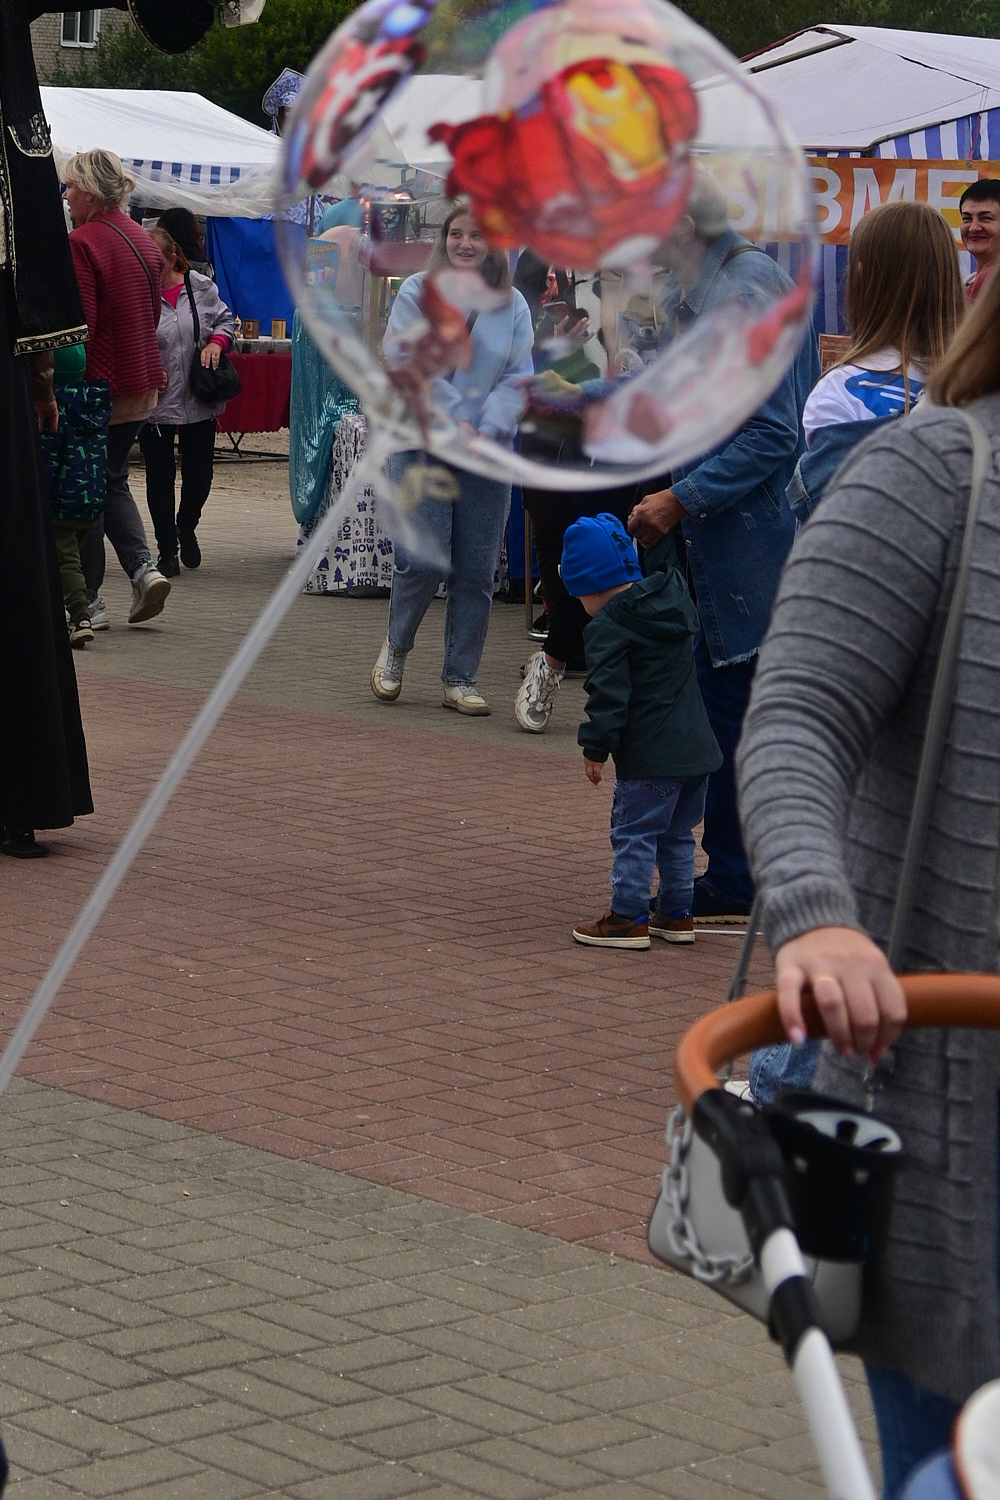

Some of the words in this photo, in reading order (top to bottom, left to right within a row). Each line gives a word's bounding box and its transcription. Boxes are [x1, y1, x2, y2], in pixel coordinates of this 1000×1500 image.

[342, 516, 351, 540] NOW
[353, 544, 375, 554] NOW
[357, 578, 379, 588] NOW
